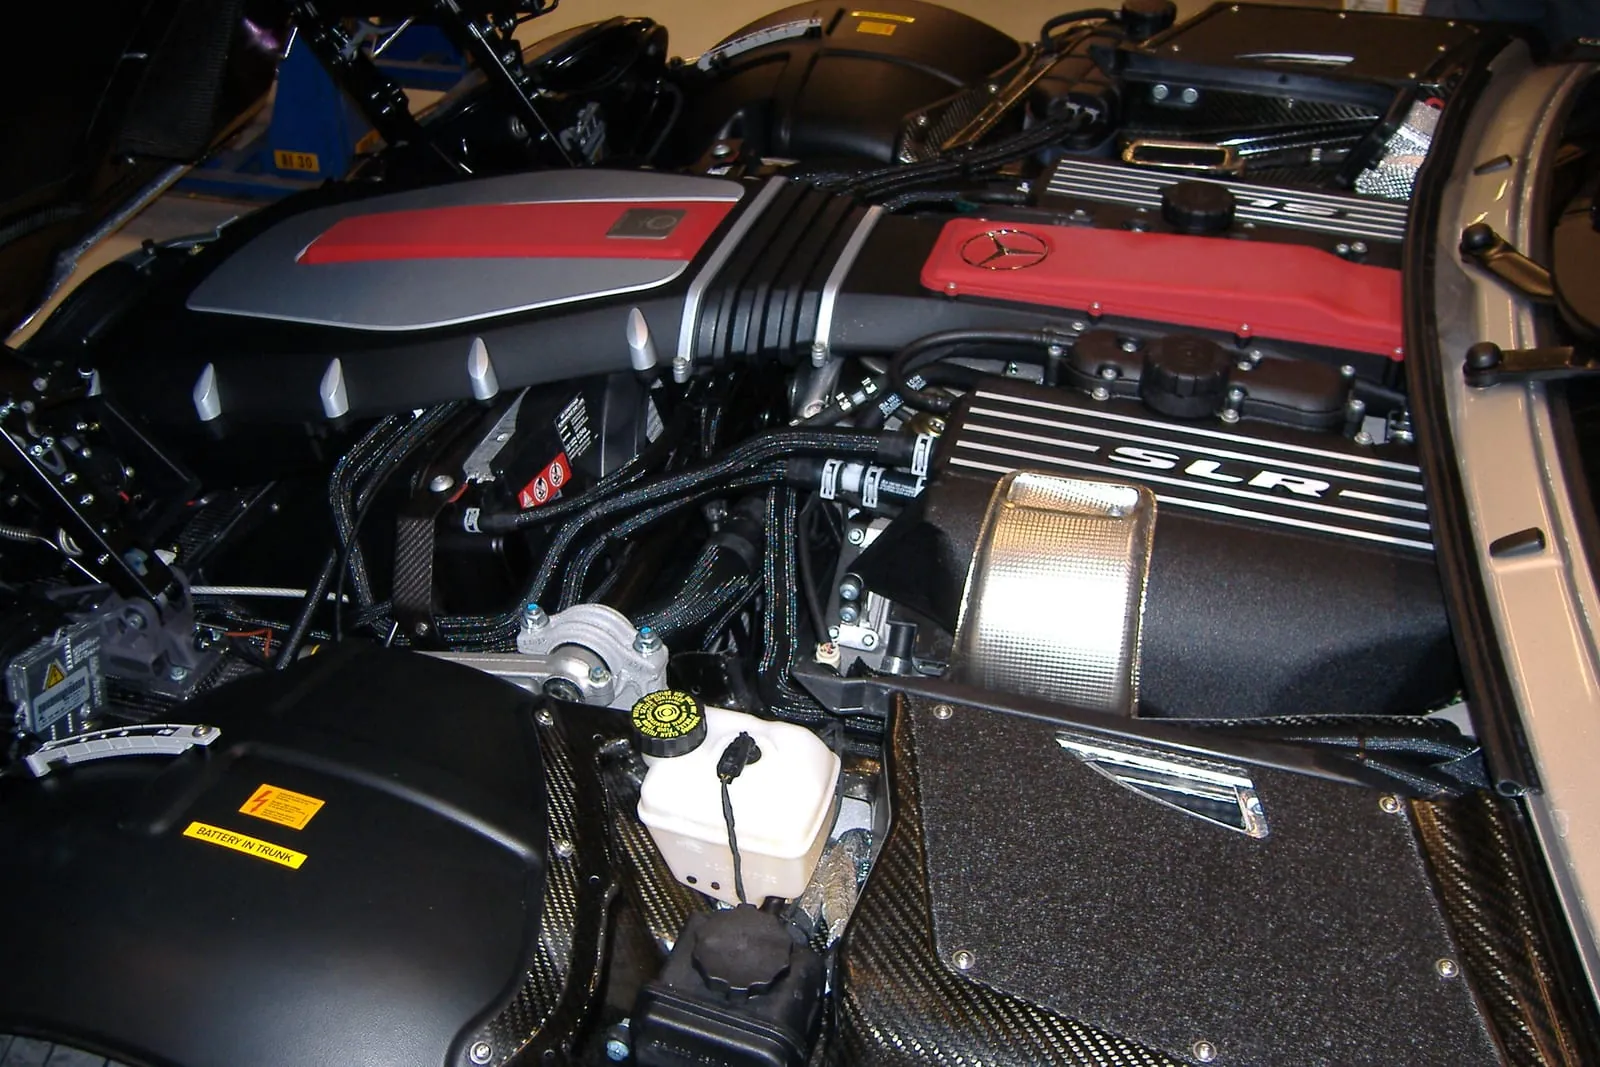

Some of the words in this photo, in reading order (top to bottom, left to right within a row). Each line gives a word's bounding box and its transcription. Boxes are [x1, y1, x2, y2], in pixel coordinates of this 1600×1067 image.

[1107, 446, 1331, 498] SLR
[196, 826, 243, 846] BATTERY
[241, 839, 256, 850] IN
[255, 844, 295, 863] TRUNK
